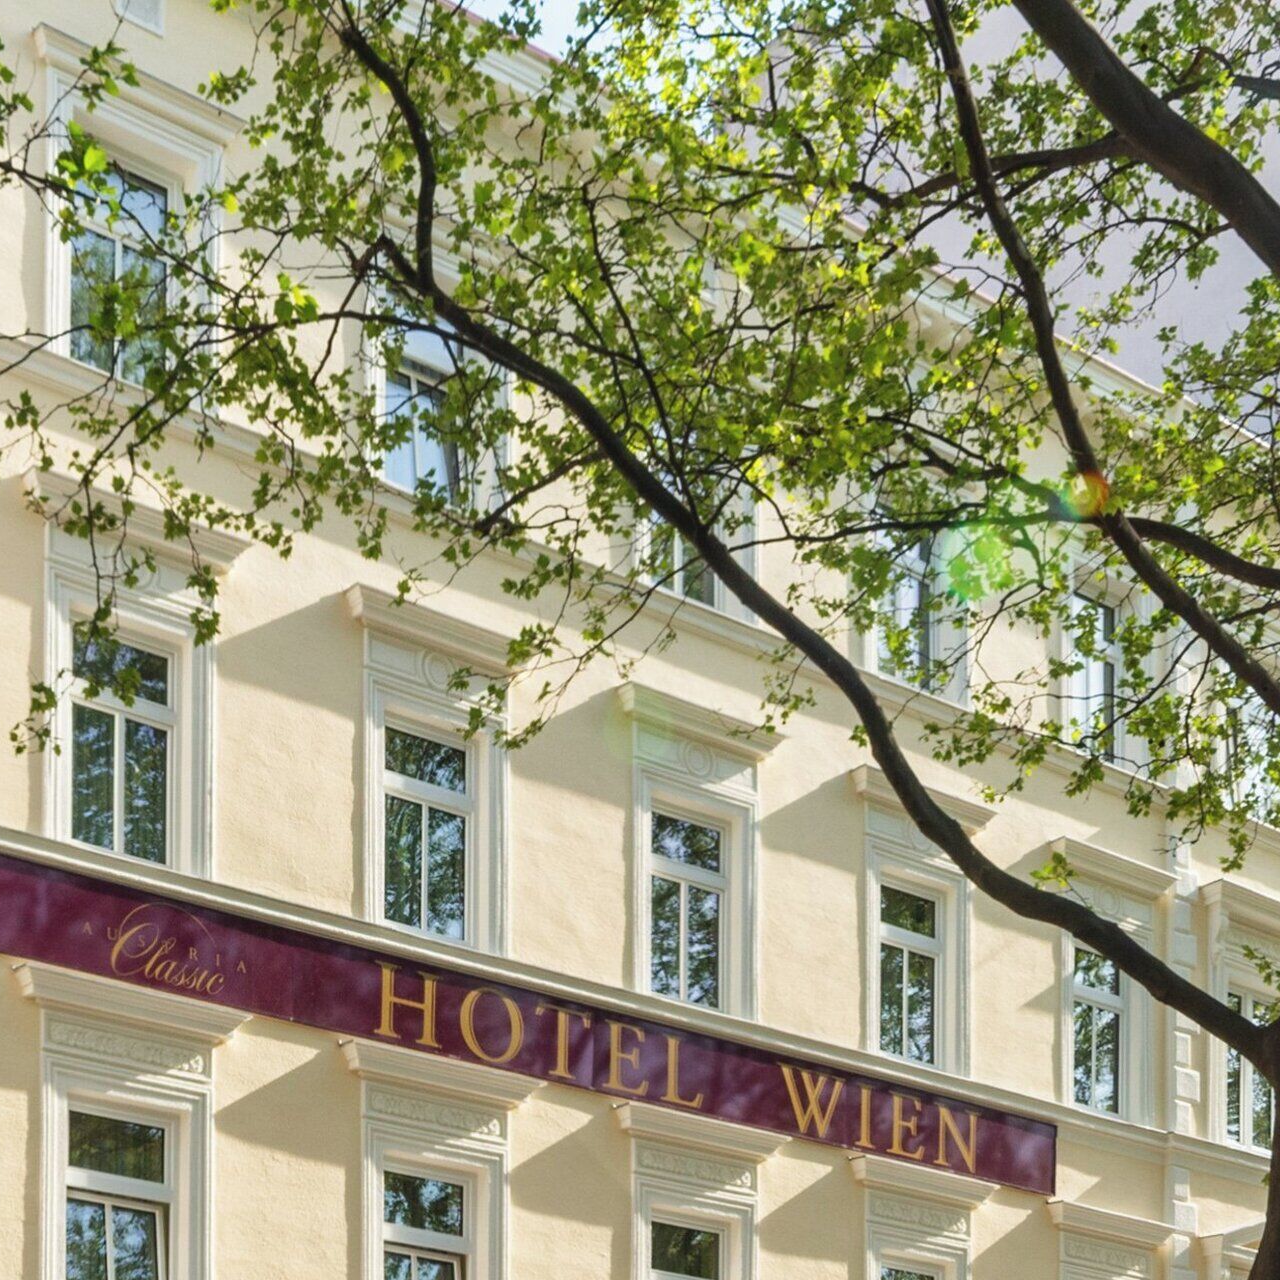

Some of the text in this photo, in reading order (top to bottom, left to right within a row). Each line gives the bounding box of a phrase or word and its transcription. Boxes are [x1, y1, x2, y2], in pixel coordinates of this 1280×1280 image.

[111, 918, 226, 995] Classic
[374, 960, 980, 1175] HOTEL WIEN
